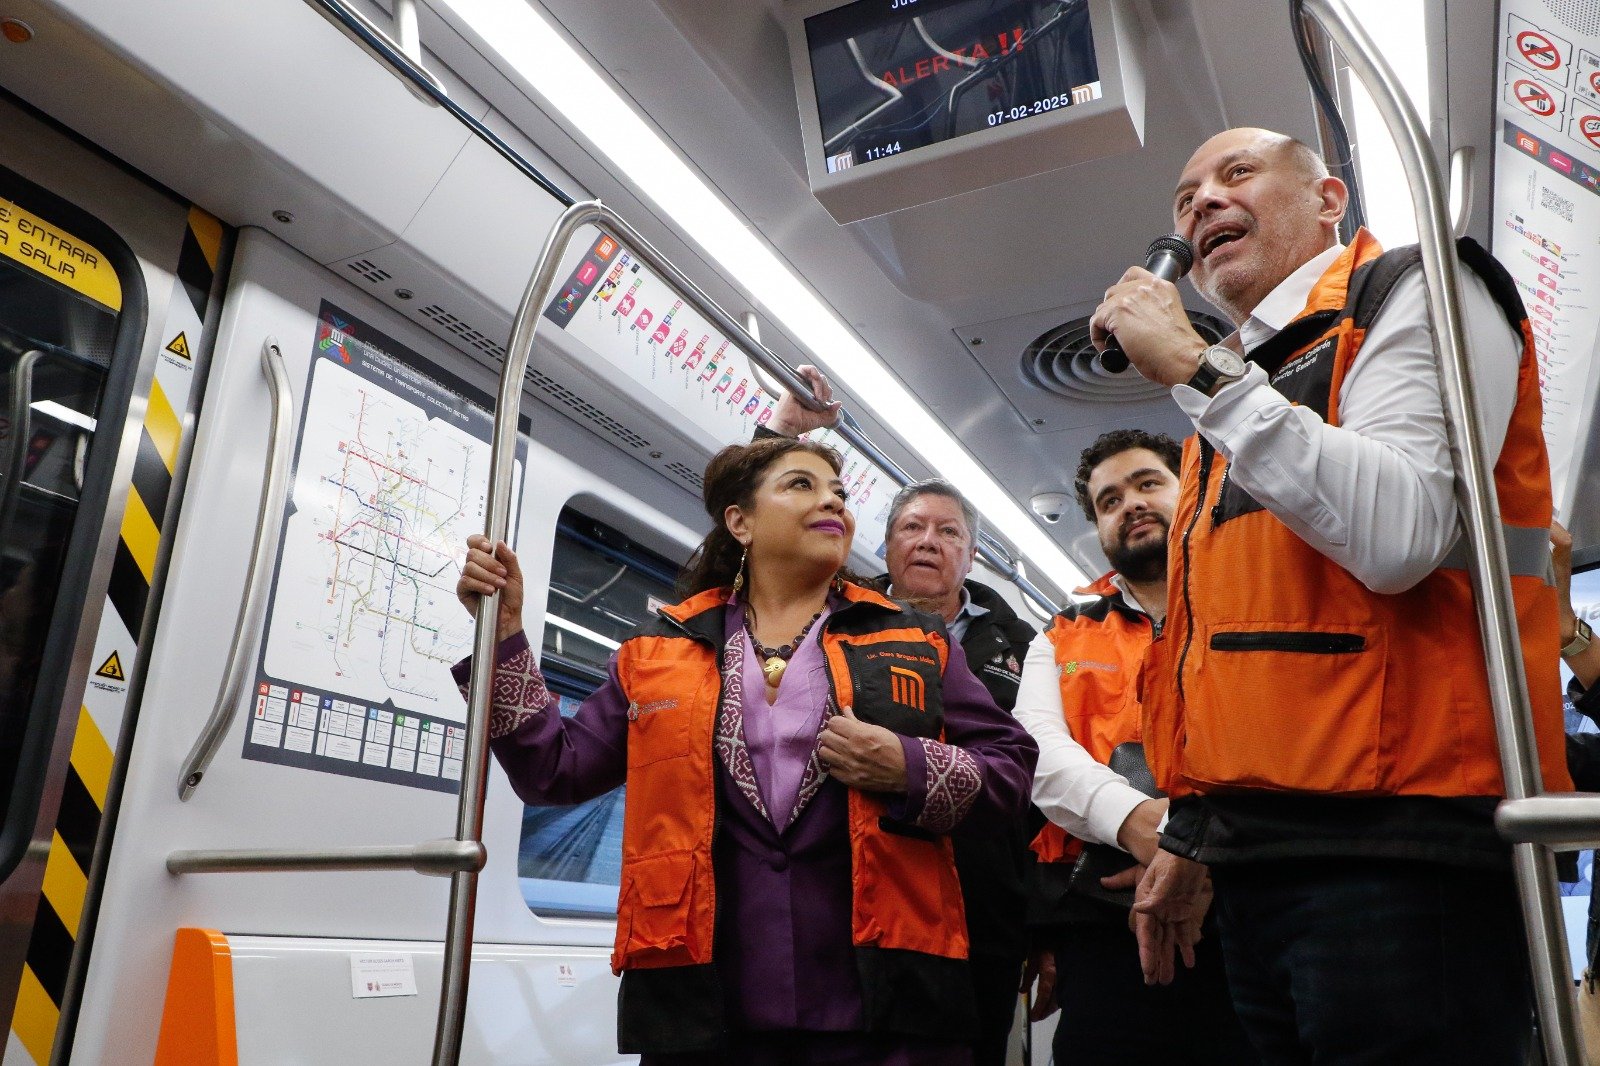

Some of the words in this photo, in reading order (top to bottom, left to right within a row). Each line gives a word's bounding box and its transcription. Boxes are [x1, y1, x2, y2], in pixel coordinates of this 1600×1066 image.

[882, 43, 990, 87] ALERTA
[987, 93, 1069, 126] 07-02-2025
[866, 141, 901, 160] 11:44
[18, 218, 98, 270] ENTRAR
[19, 241, 76, 279] SALIR
